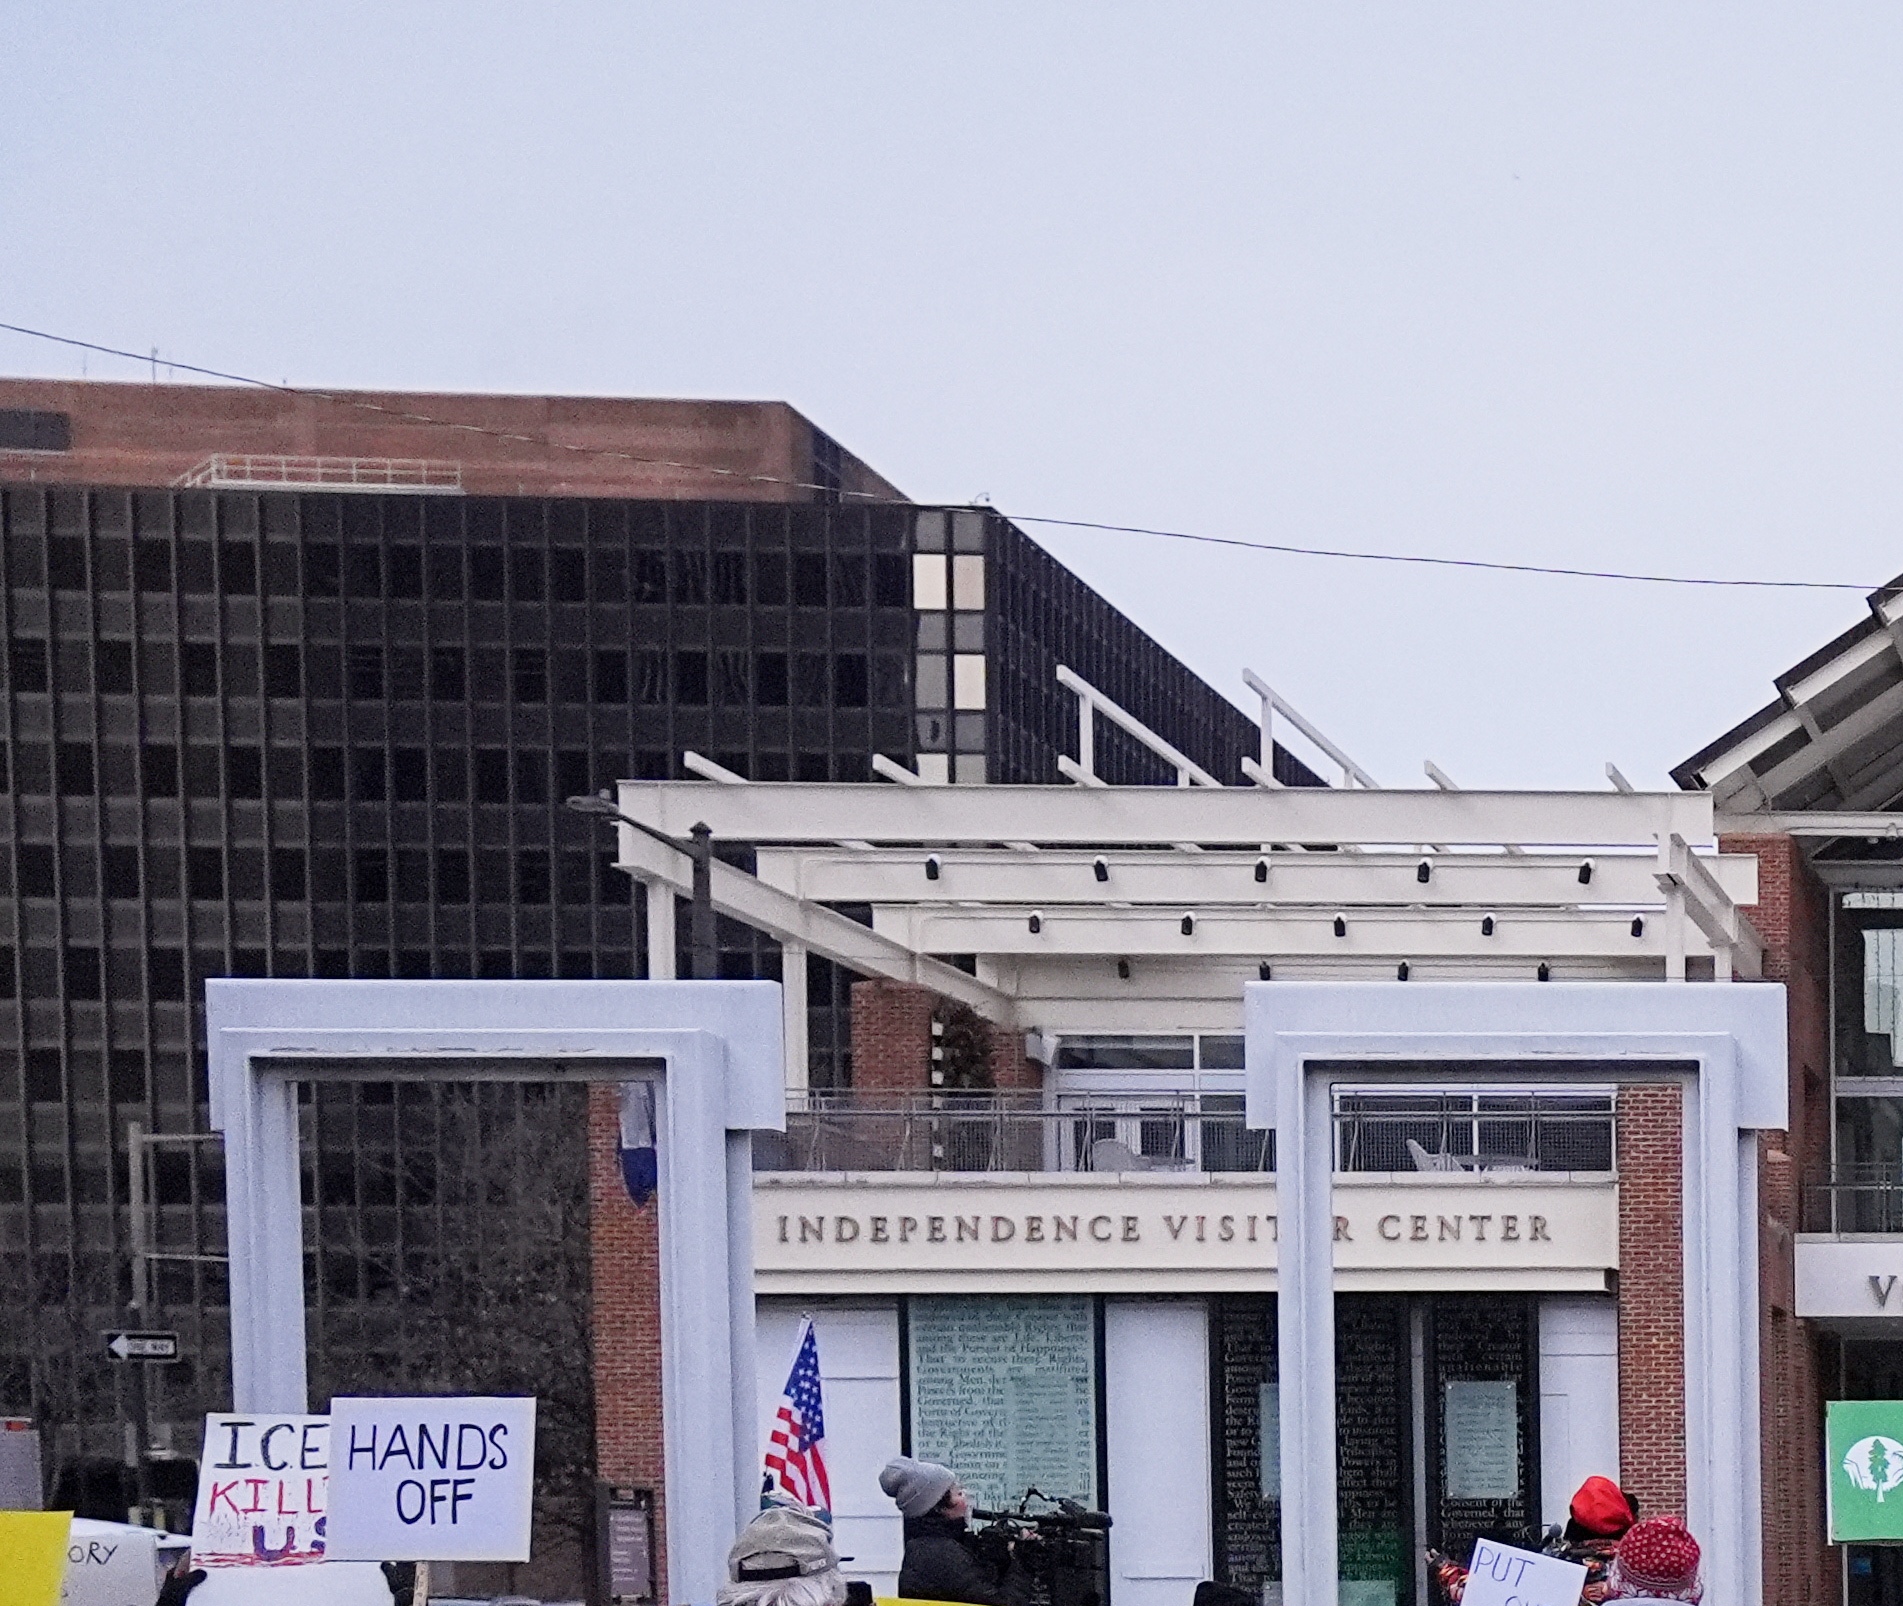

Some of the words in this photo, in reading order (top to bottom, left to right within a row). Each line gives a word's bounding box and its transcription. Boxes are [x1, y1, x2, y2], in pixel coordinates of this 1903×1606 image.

[777, 1215, 1140, 1242] INDEPENDENCE
[1162, 1214, 1354, 1242] VISITR
[1377, 1214, 1551, 1242] CENTER
[348, 1423, 508, 1472] HANDS
[396, 1477, 476, 1525] OFF
[1473, 1546, 1536, 1588] PUT
